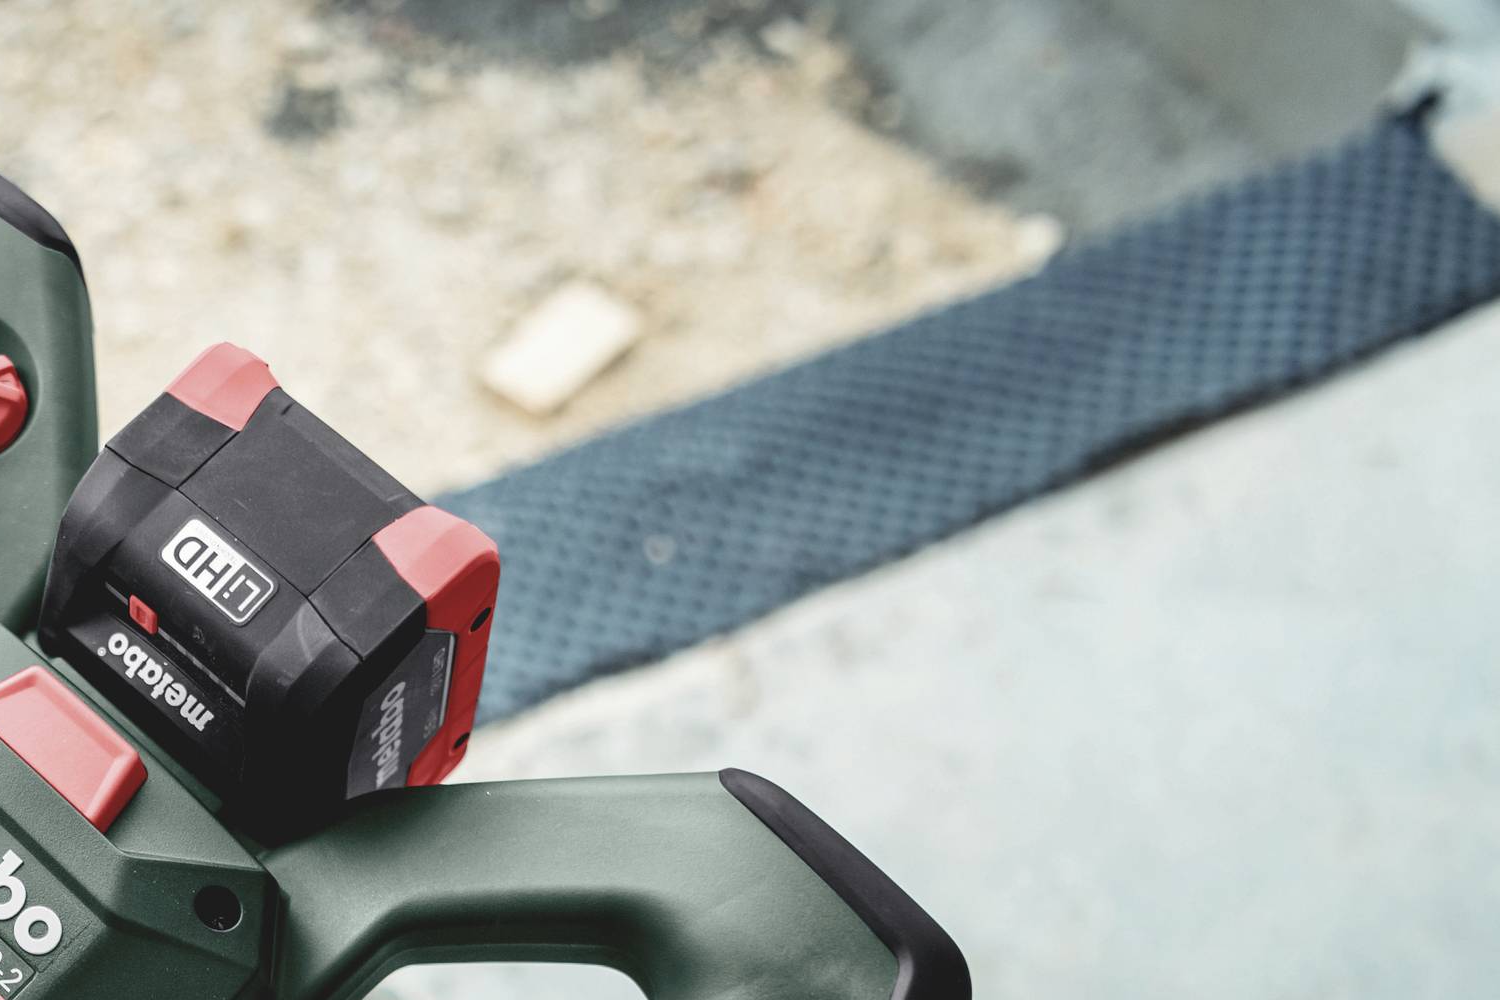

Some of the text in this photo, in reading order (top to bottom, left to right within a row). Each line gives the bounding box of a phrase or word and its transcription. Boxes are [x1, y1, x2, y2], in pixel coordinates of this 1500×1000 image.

[173, 535, 261, 613] LiHD
[107, 632, 215, 732] metabo
[371, 681, 406, 789] metabo
